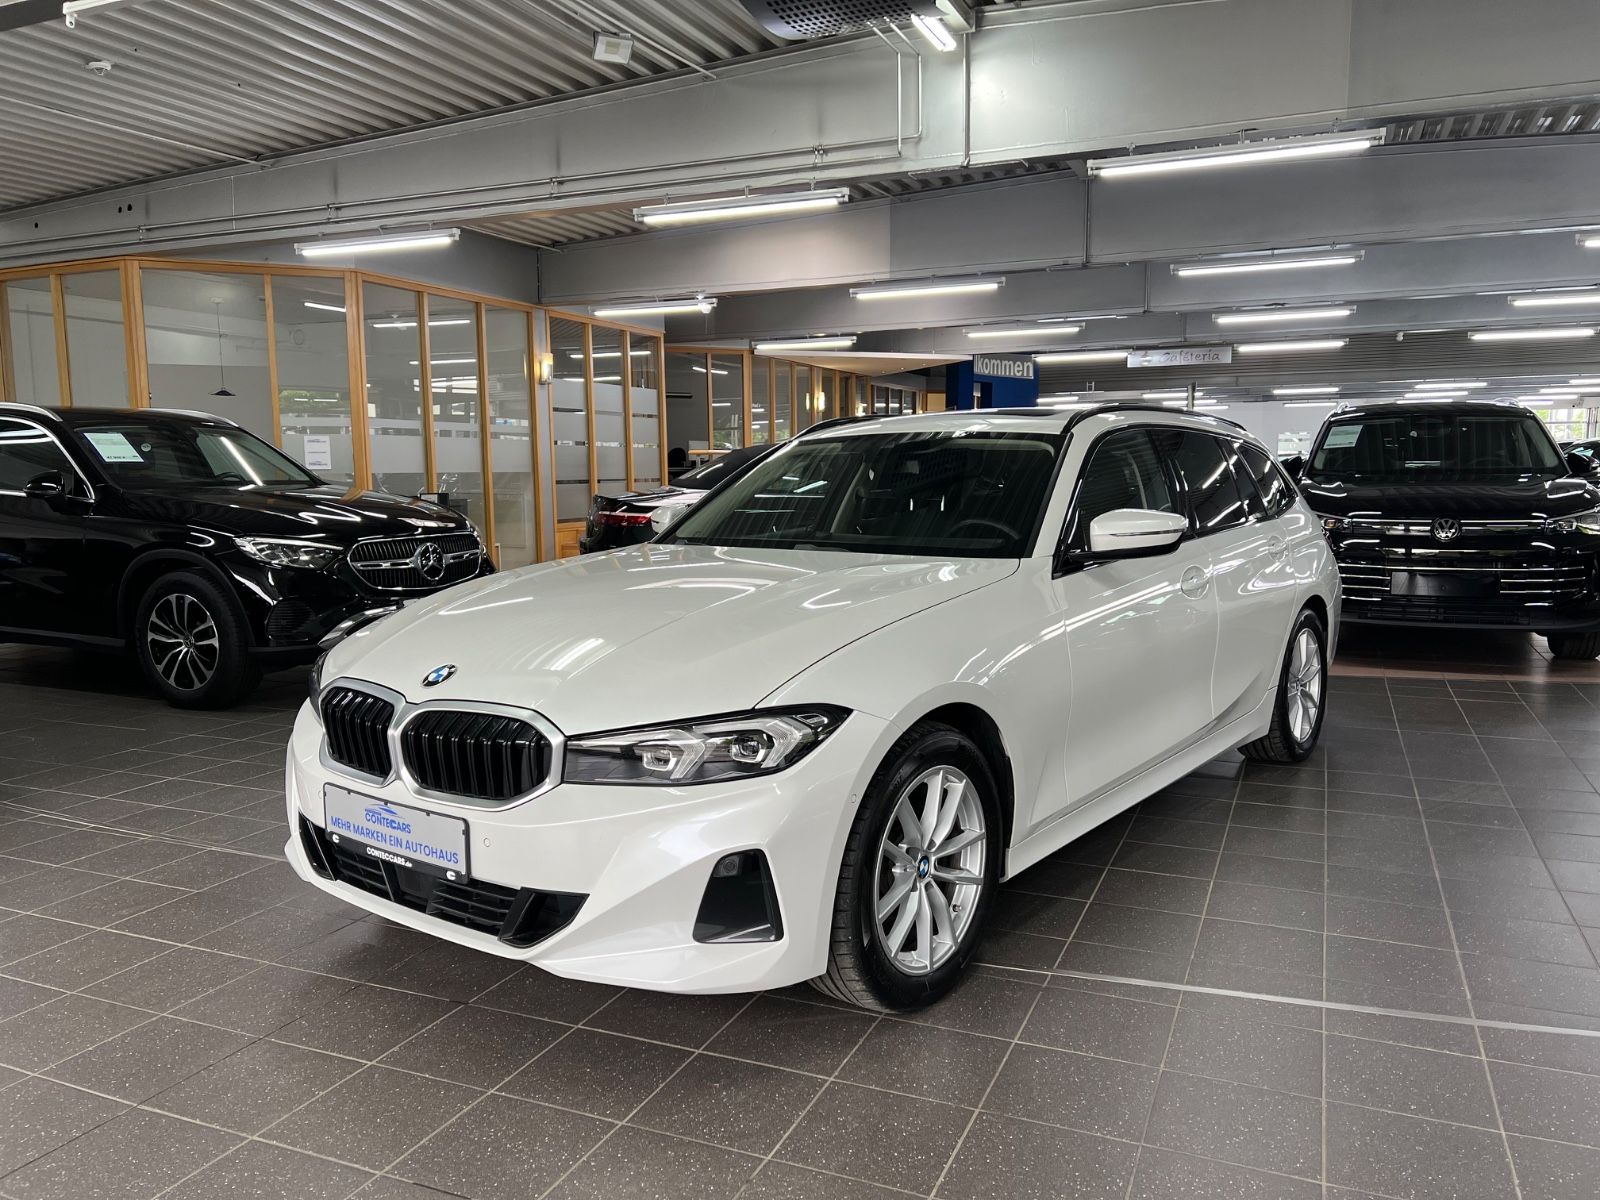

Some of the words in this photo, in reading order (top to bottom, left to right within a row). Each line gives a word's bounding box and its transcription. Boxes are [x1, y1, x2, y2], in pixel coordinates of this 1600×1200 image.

[330, 815, 352, 833] MEHR
[352, 822, 387, 846] MARKEN
[388, 834, 403, 849] EIN
[405, 840, 459, 865] AUTOHAUS
